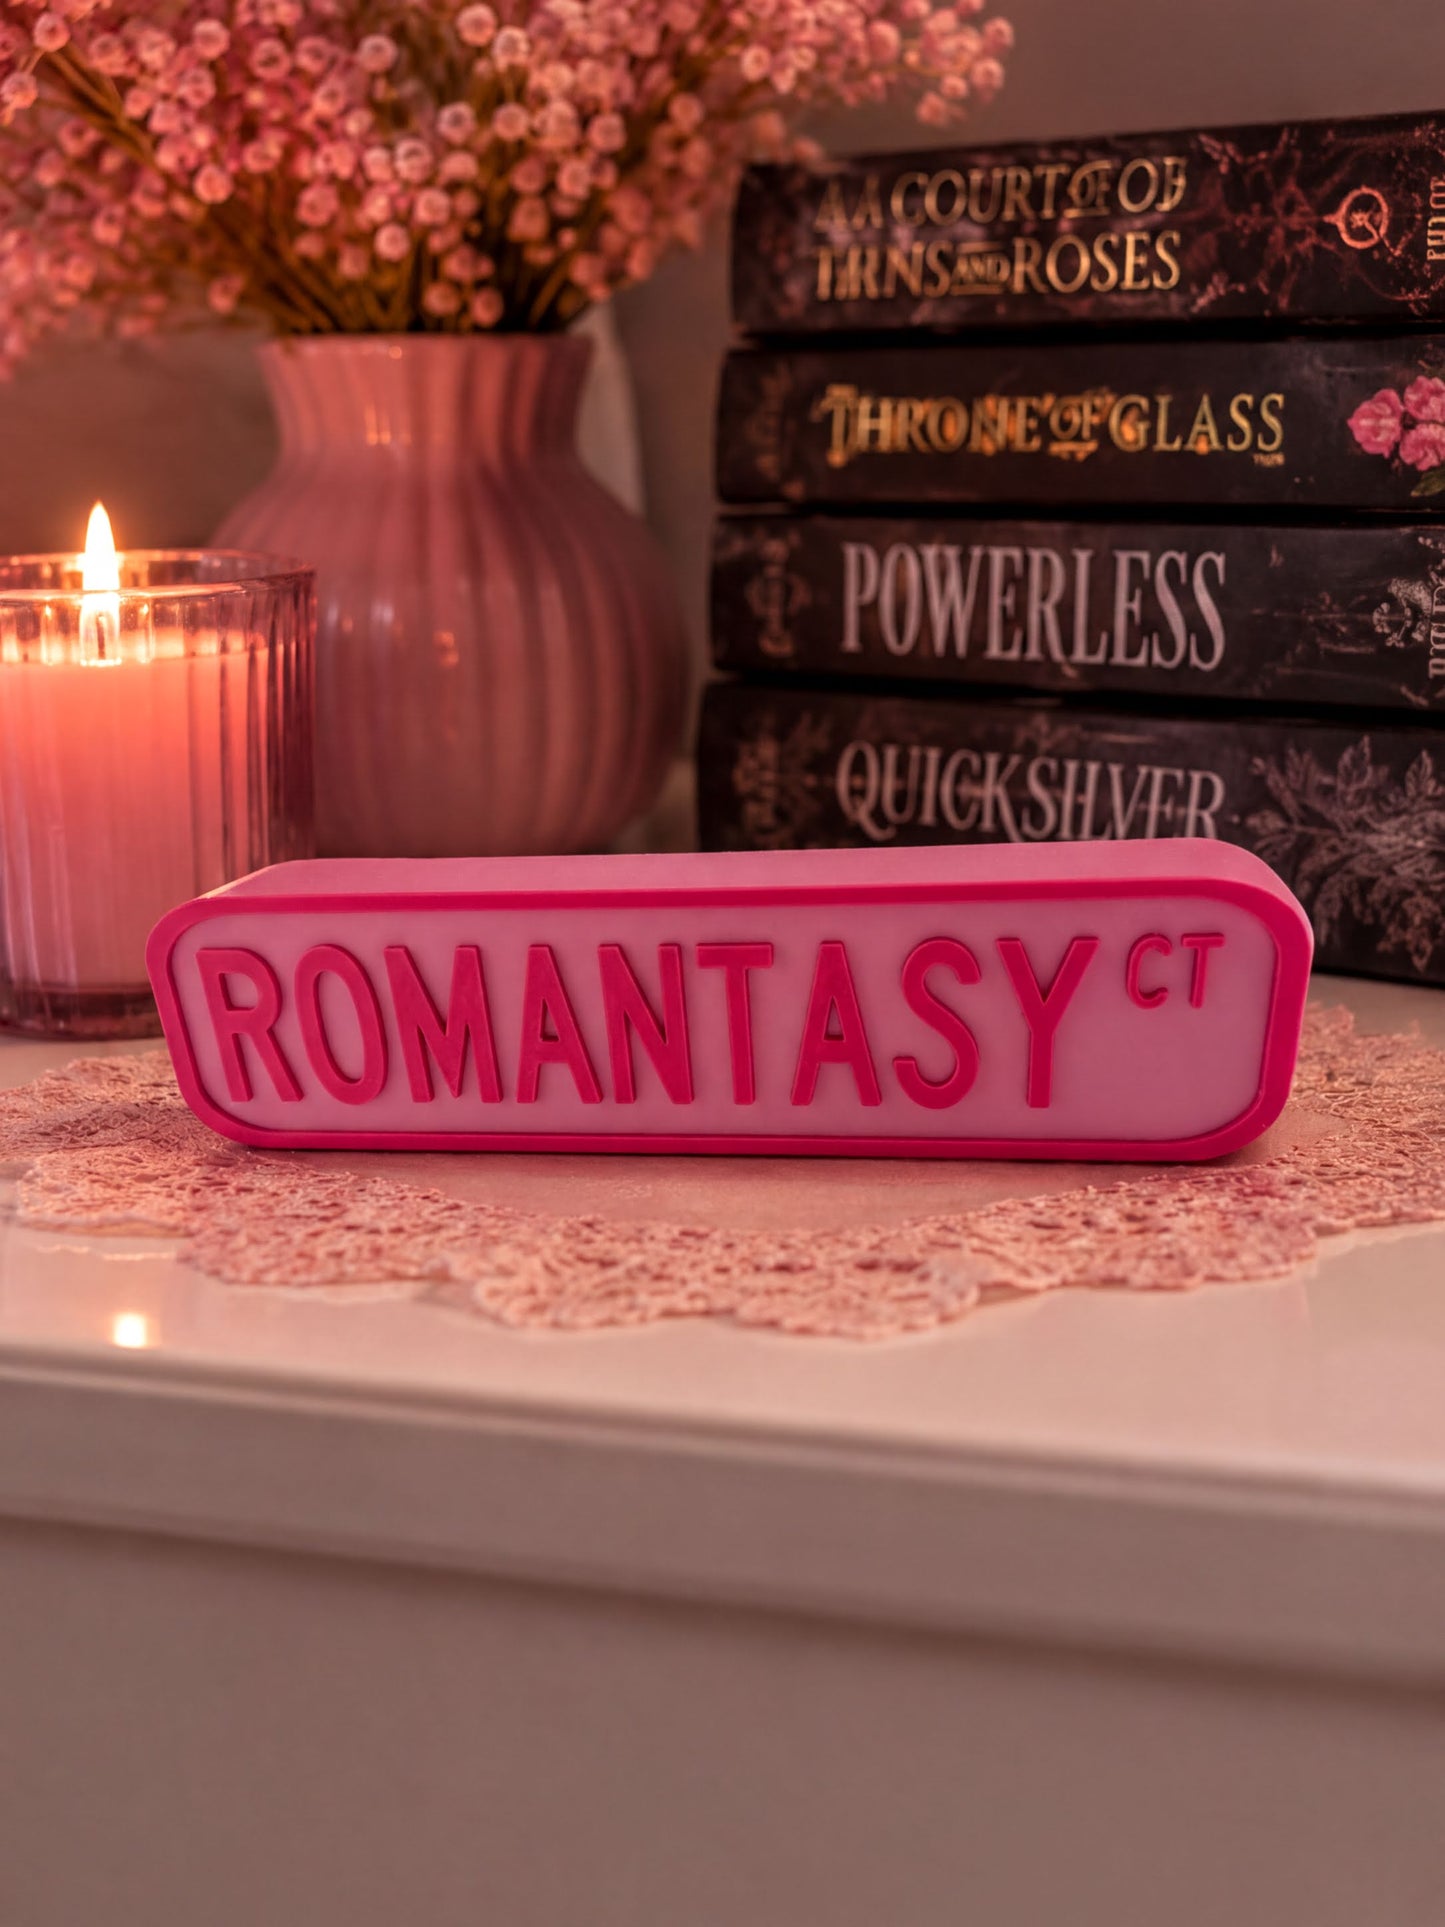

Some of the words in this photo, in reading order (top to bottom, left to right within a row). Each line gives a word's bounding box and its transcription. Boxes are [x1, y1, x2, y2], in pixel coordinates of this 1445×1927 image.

[889, 162, 1071, 228] COURT
[1012, 229, 1182, 295] ROSES
[823, 385, 1043, 464] THRONE
[1048, 396, 1109, 459] OF
[1108, 392, 1286, 455] GLASS
[841, 541, 1227, 673] POWERLESS
[196, 934, 1101, 1109] ROMANTASY
[1125, 931, 1226, 1010] CT
